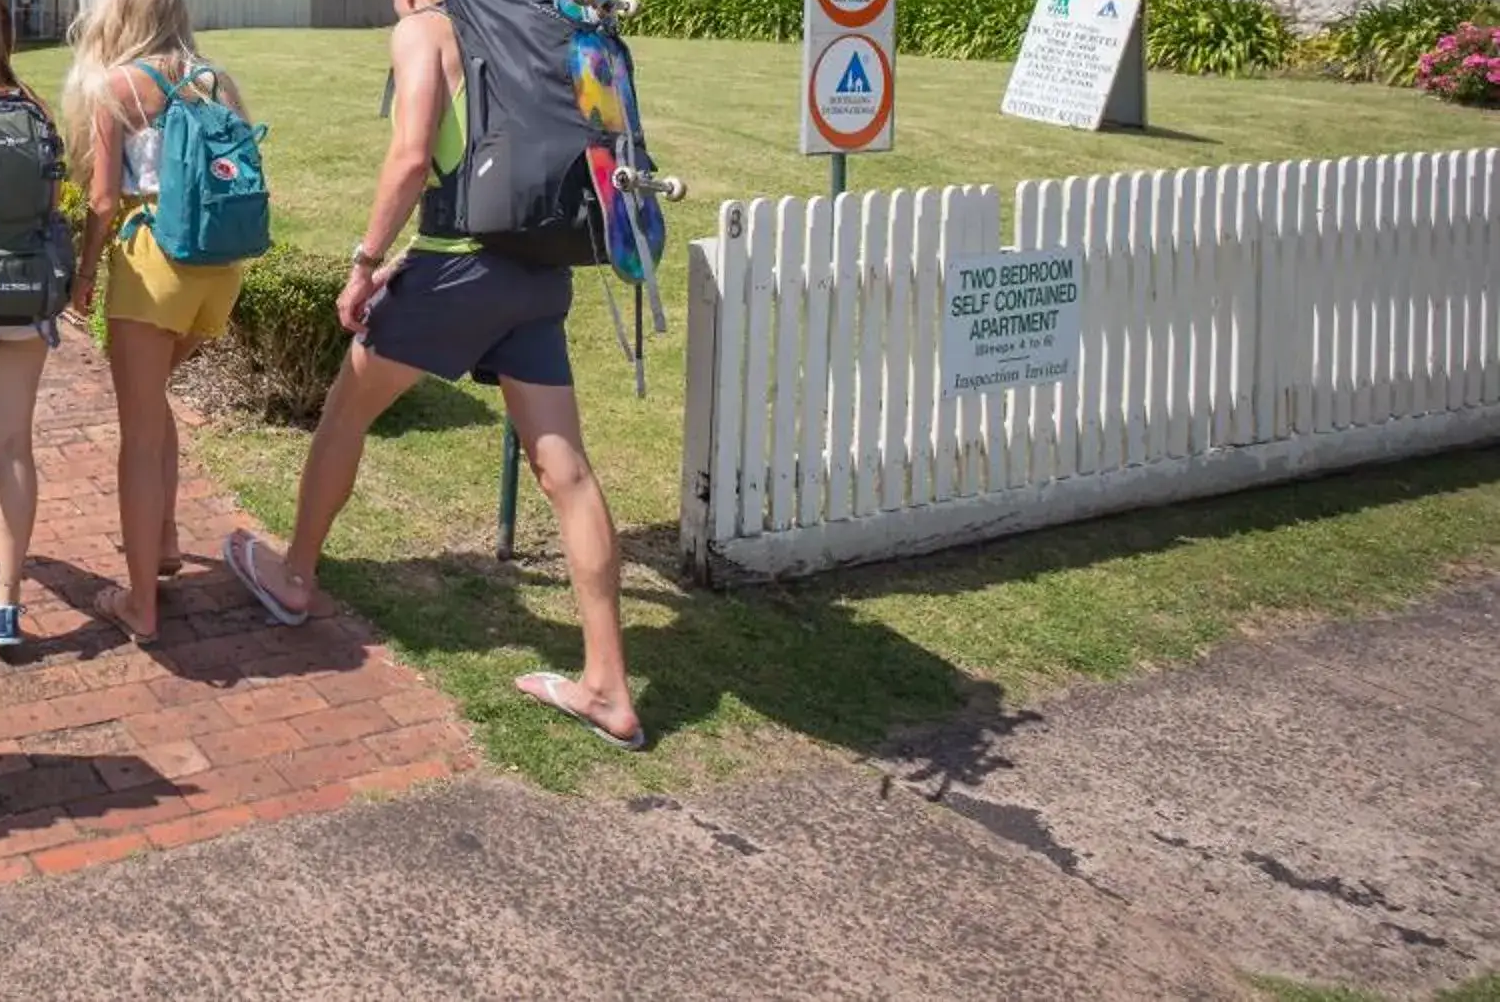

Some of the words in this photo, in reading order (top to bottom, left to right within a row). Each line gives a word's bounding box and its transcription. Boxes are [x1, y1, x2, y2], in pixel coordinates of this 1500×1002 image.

[1031, 25, 1071, 40] YOUTH
[1074, 30, 1118, 47] HOSTEL
[729, 208, 742, 239] 8
[959, 266, 997, 290] TWO
[1000, 258, 1074, 286] BEDROOM
[951, 292, 990, 317] SELF
[995, 283, 1077, 312] CONTAINED
[969, 310, 1060, 341] APARTMENT
[1019, 339, 1026, 349] 4
[1030, 337, 1041, 348] to
[954, 368, 1019, 391] Inspection
[1025, 358, 1069, 379] Invited
